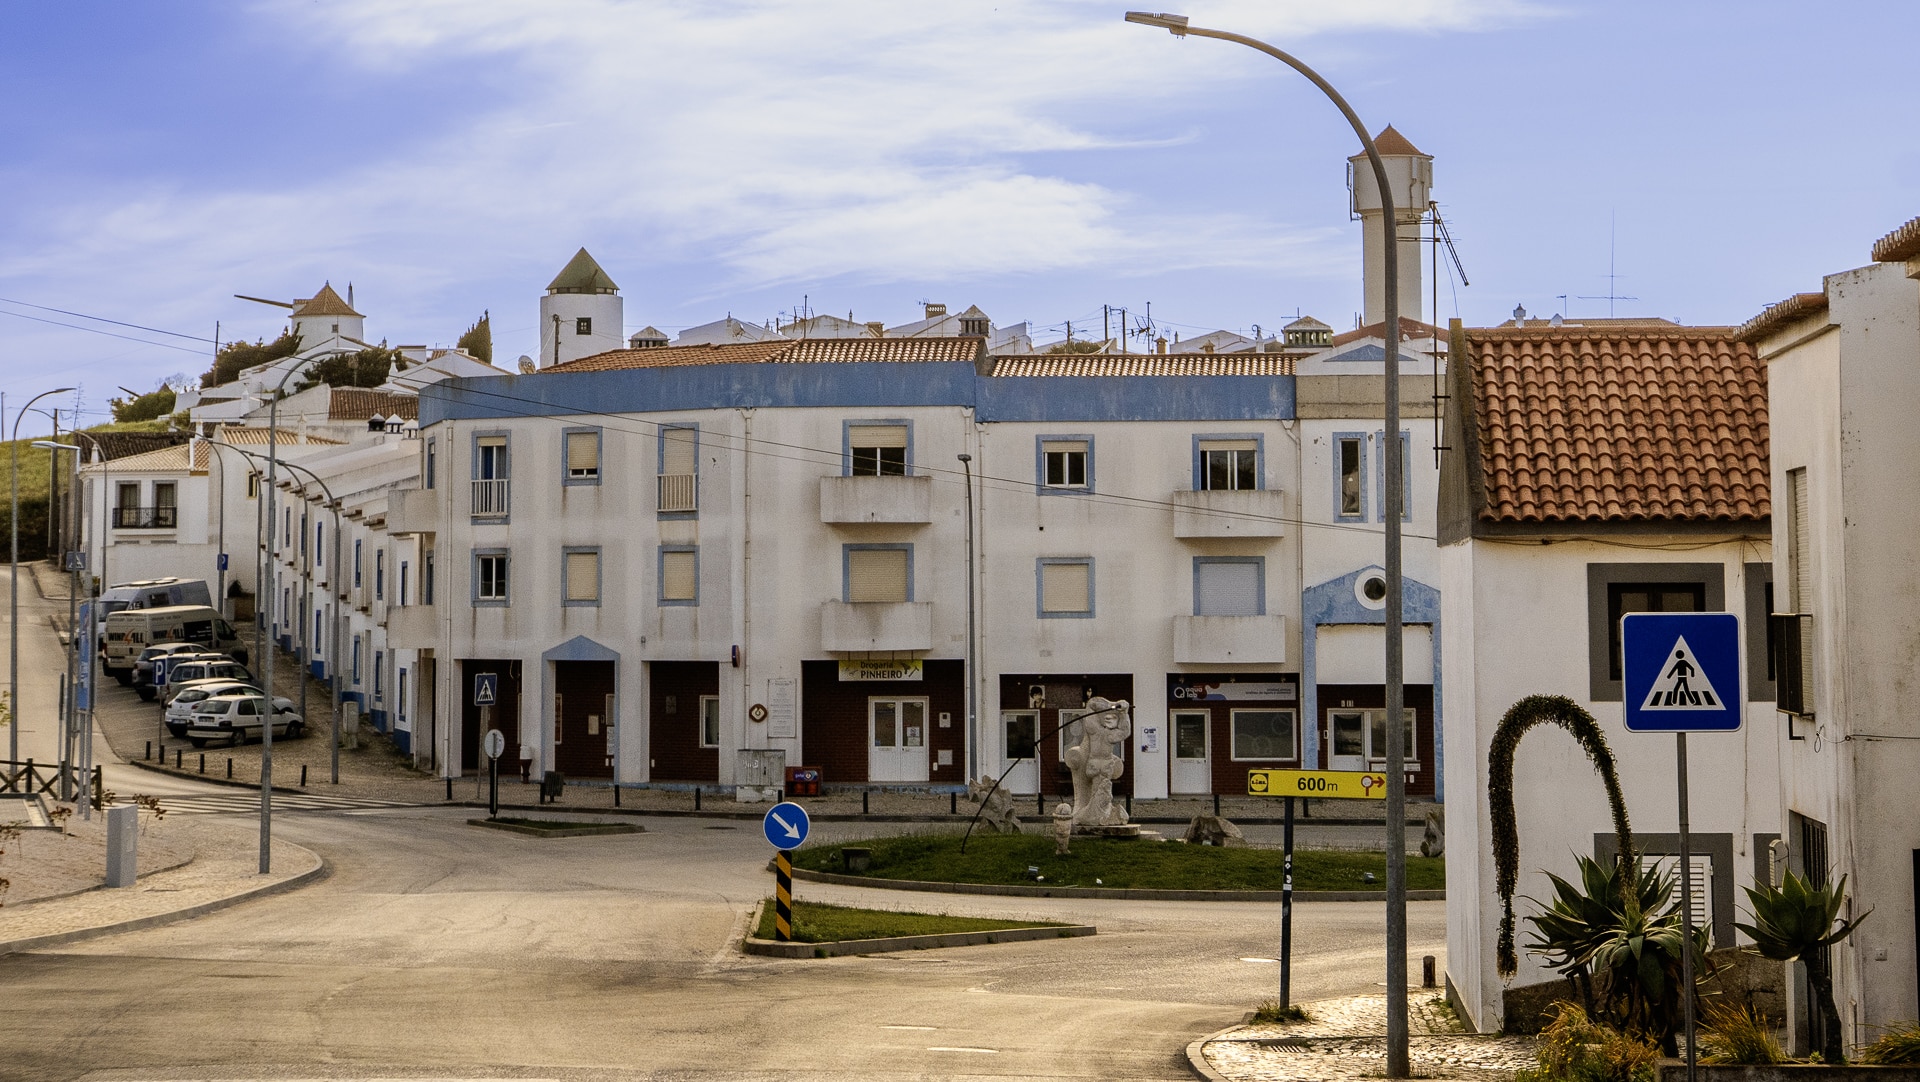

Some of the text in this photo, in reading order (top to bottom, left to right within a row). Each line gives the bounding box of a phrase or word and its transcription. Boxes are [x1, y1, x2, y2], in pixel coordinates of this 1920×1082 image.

[860, 661, 894, 670] Drogaria
[155, 662, 164, 683] P
[860, 670, 903, 679] PINHEIRO
